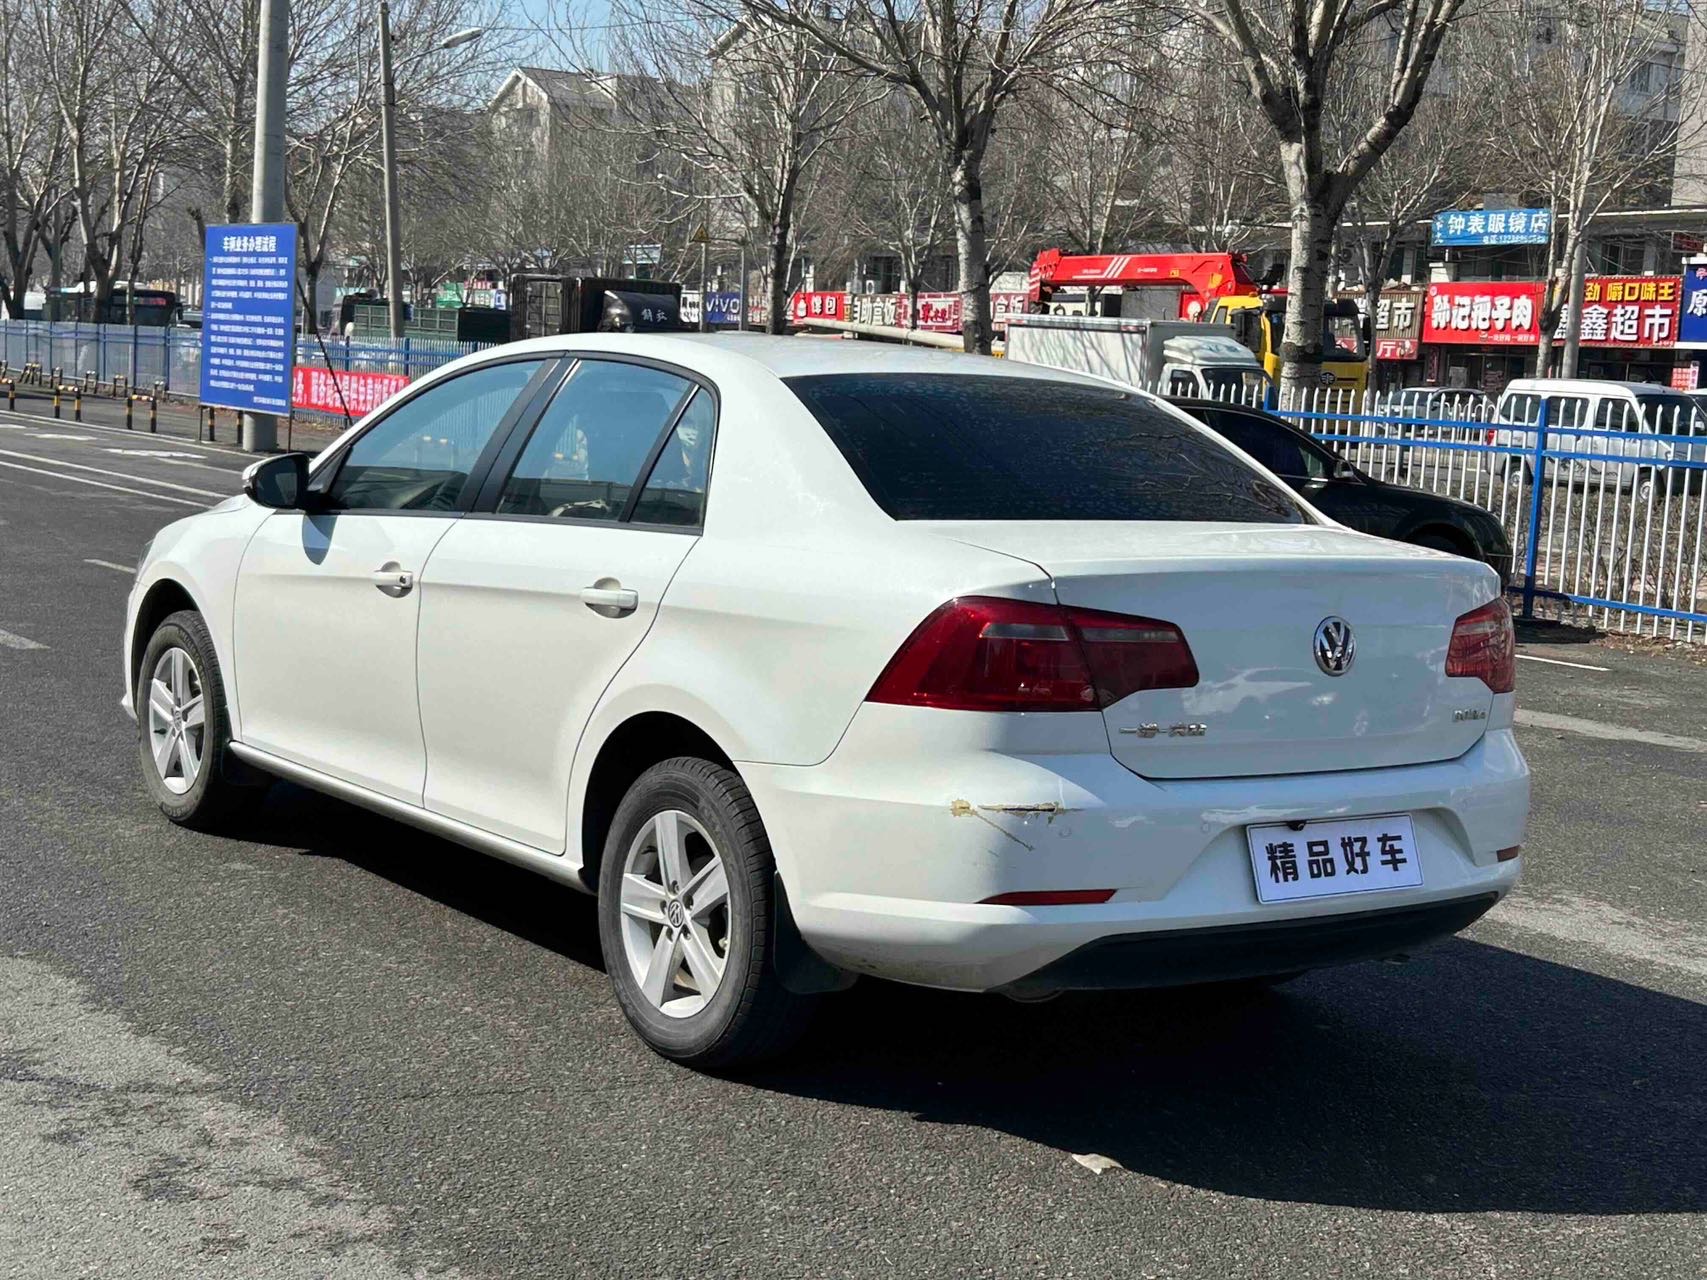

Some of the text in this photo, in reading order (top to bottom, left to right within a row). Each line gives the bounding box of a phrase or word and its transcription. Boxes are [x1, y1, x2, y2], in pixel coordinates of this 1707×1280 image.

[1448, 211, 1549, 235] 钟表眼镜店
[706, 294, 740, 314] vivo
[853, 296, 897, 326] 自助盒饭
[1264, 831, 1409, 885] 精品好车
